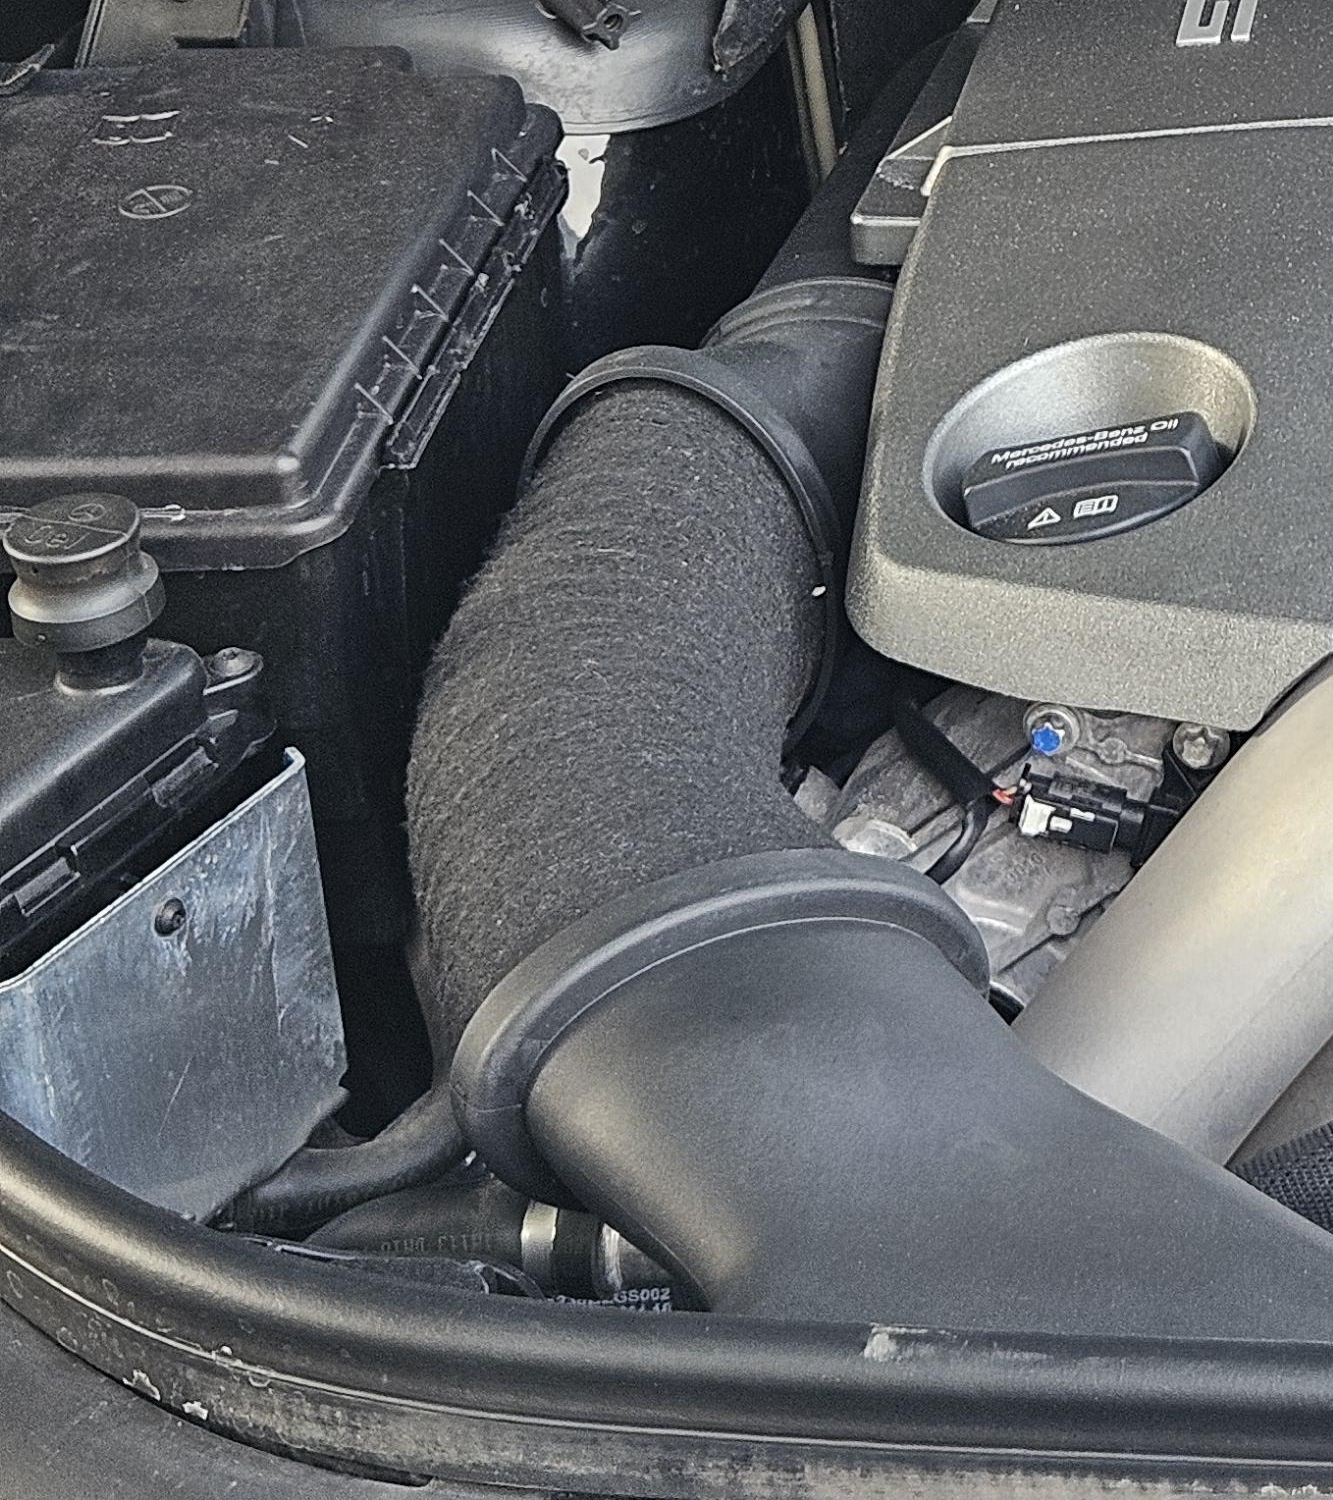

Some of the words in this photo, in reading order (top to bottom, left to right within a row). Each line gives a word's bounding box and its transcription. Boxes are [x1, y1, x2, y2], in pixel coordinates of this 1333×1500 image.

[990, 424, 1147, 465] Mercedes-Benz
[1149, 417, 1179, 432] Oil
[1005, 432, 1148, 470] recommended
